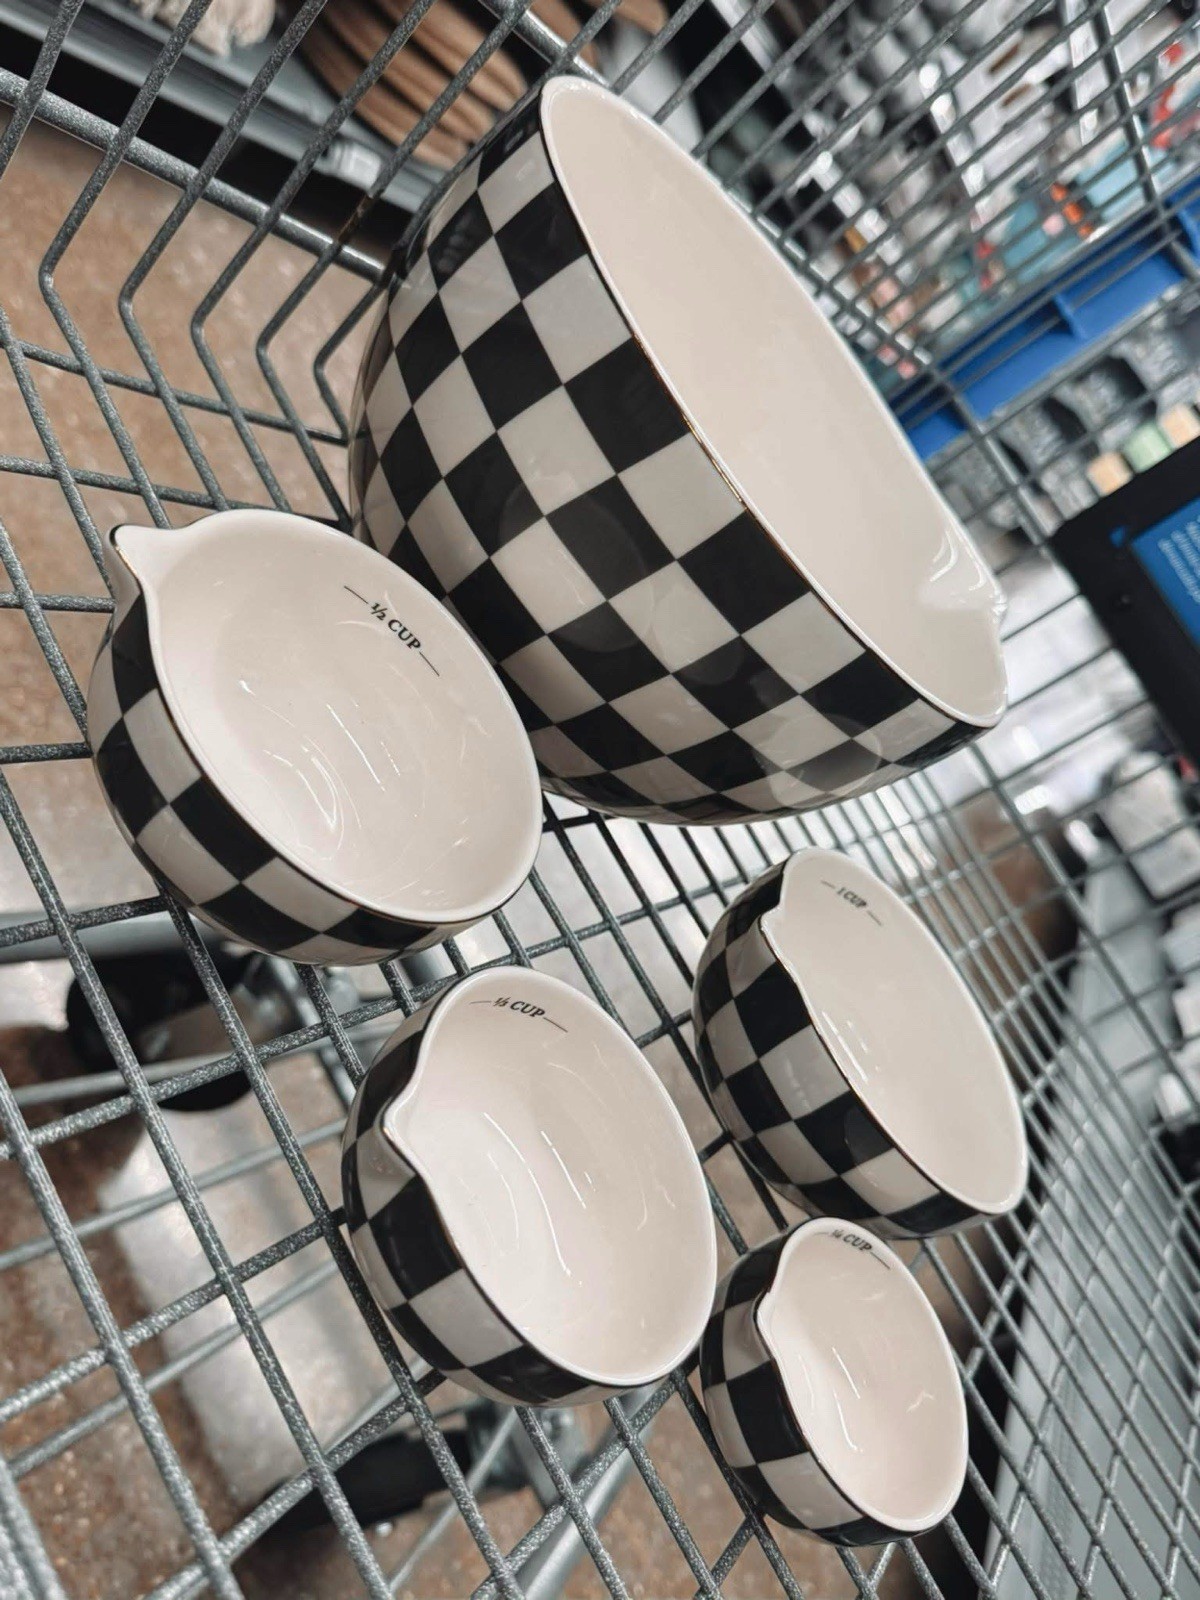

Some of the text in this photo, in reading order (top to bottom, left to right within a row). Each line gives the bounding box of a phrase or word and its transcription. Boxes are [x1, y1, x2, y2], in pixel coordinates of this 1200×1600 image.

[387, 619, 421, 649] CUP
[843, 891, 867, 908] CUP
[510, 1001, 545, 1017] CUP
[843, 1233, 872, 1251] CUP
